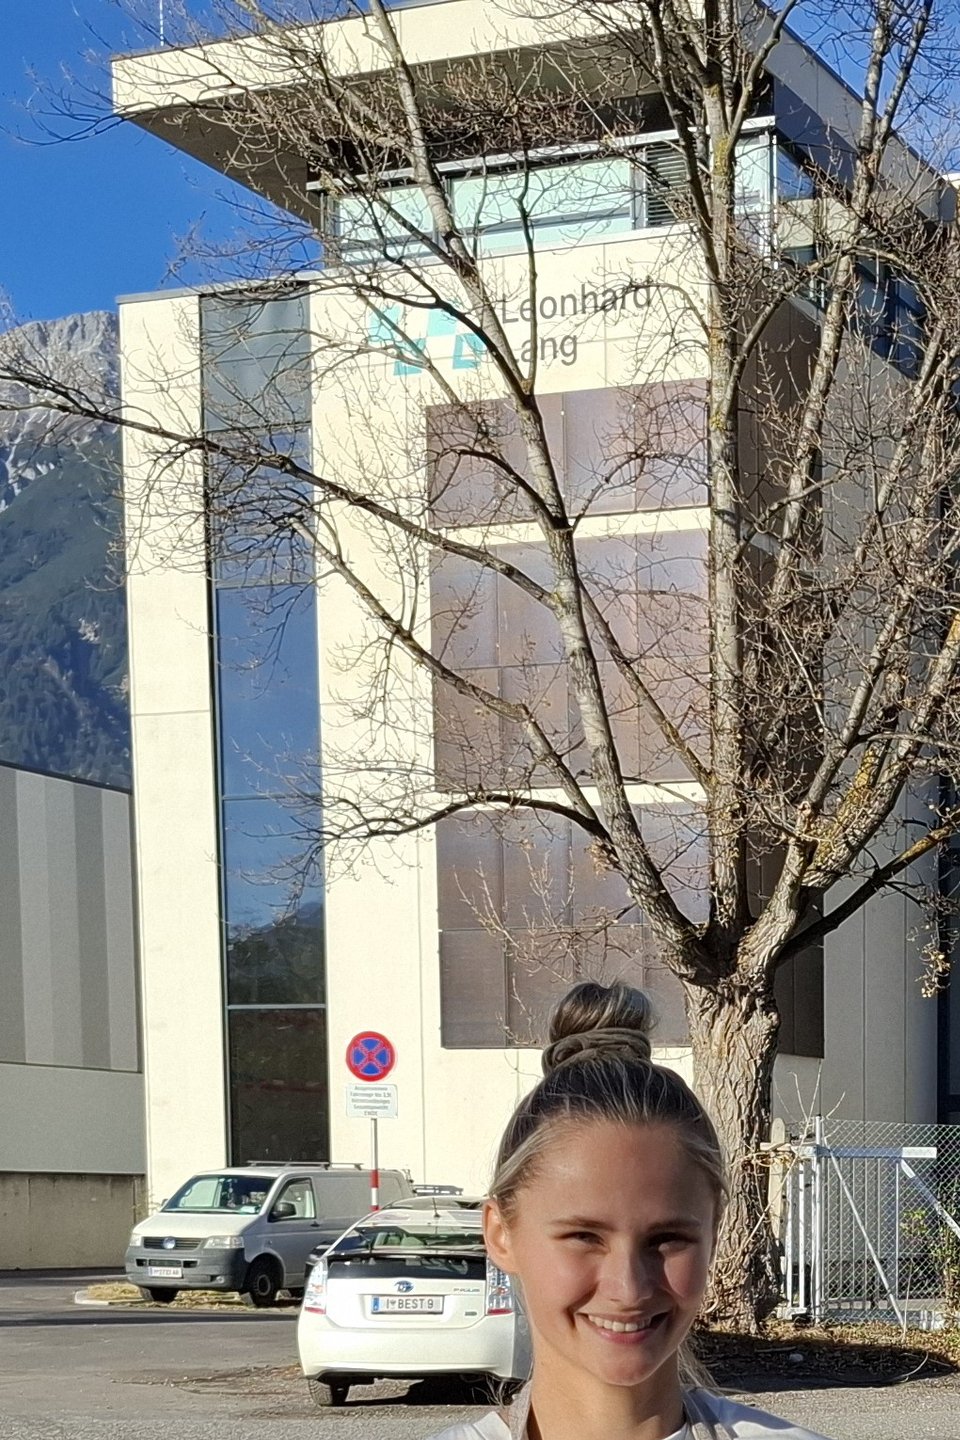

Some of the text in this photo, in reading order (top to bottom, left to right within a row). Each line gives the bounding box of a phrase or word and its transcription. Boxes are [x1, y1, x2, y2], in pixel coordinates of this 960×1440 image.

[502, 283, 650, 323] Leonhard
[517, 335, 578, 366] ang
[398, 1298, 425, 1310] BEST
